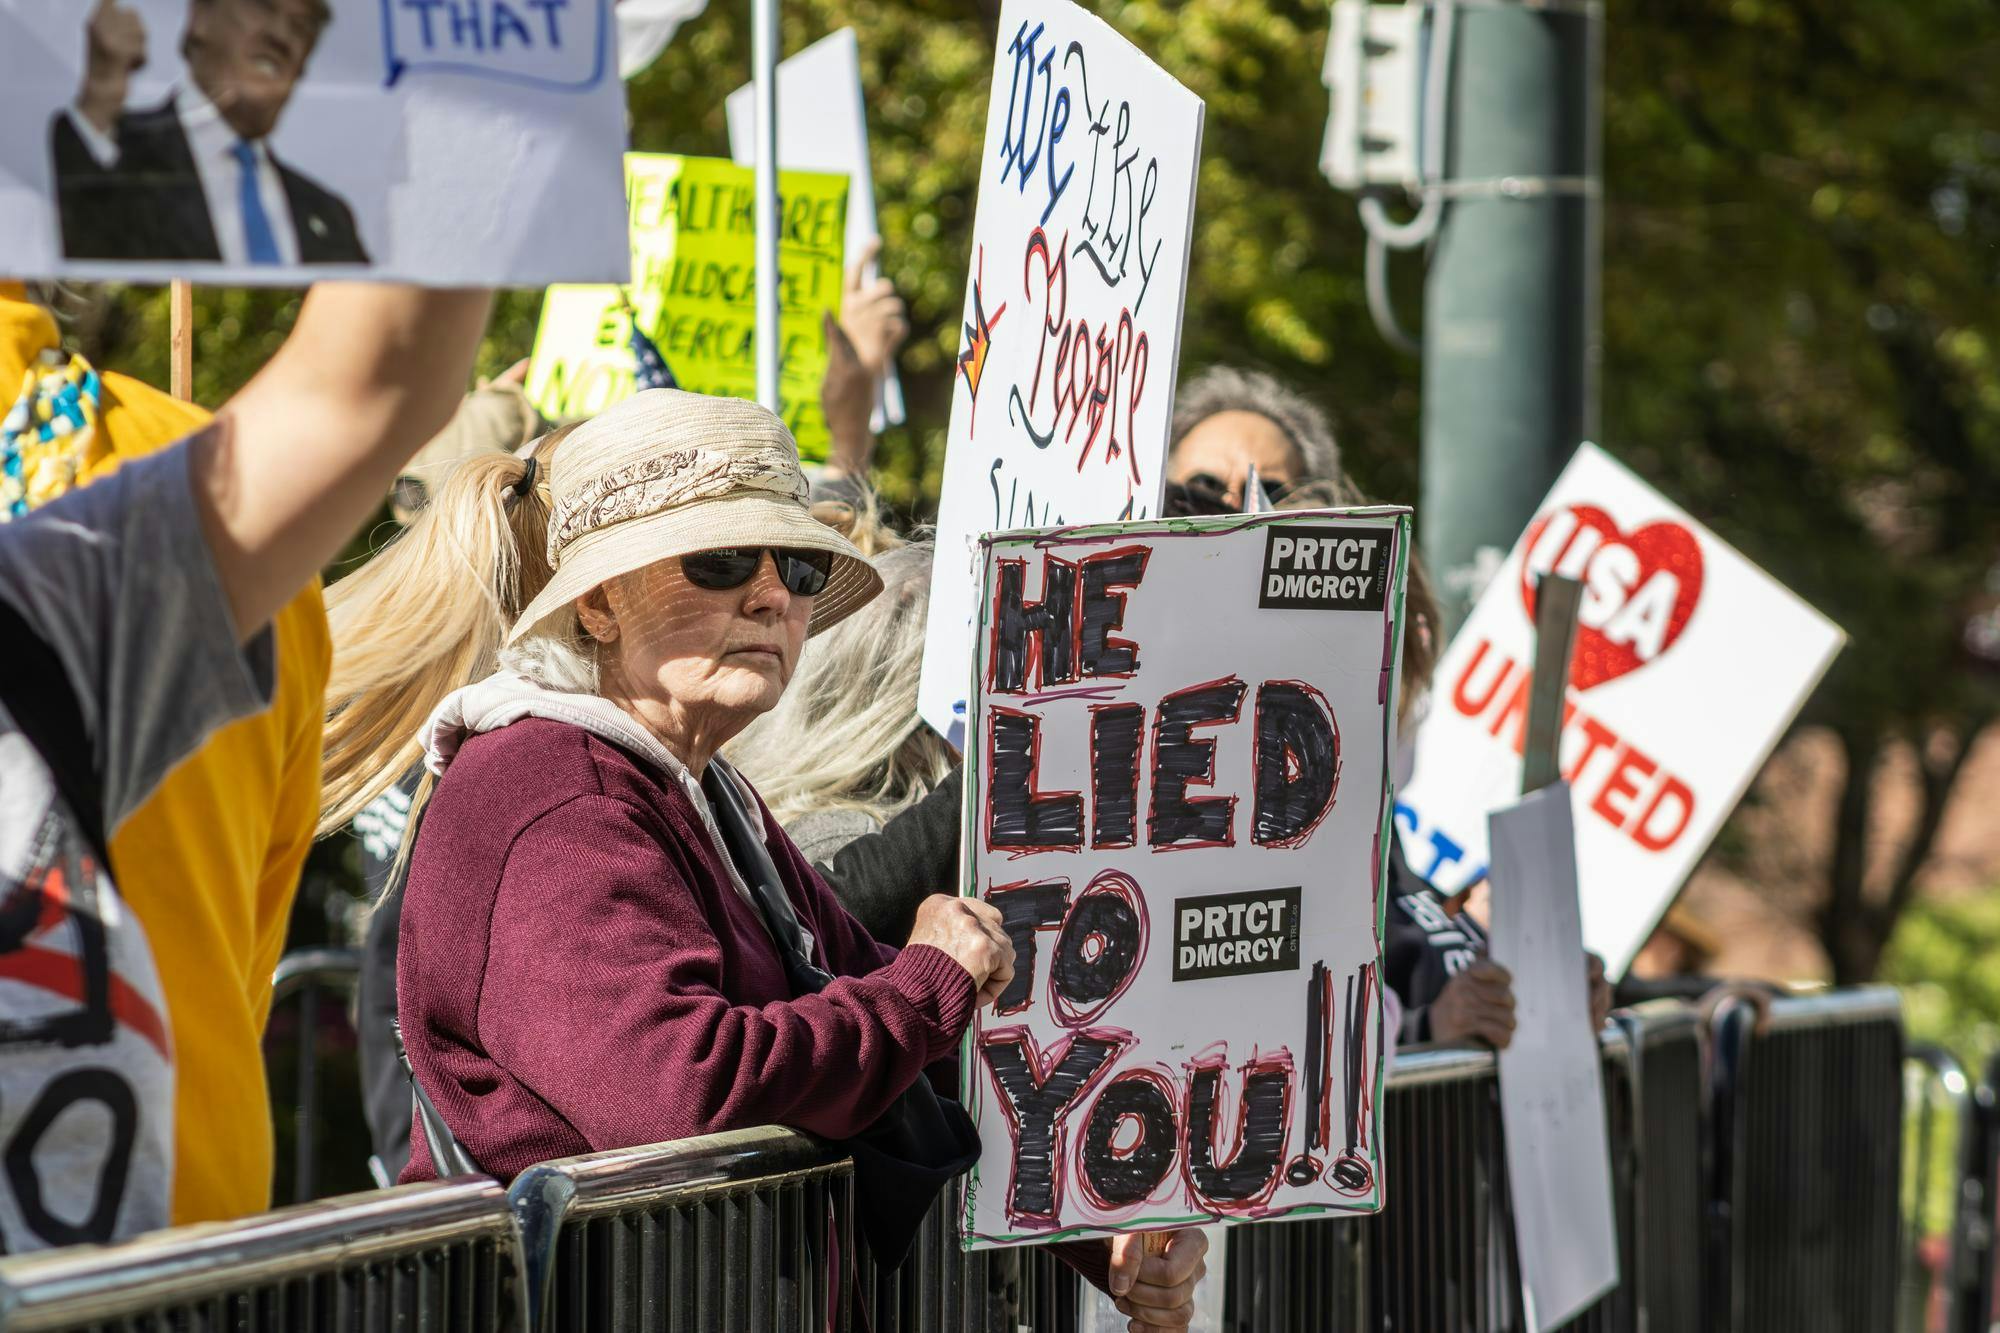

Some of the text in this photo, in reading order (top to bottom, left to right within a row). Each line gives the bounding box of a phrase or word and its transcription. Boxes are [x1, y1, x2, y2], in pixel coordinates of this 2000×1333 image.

[402, 0, 568, 51] THAT
[1000, 19, 1075, 228] We
[1010, 226, 1150, 486] People
[1267, 574, 1372, 599] DMCRCY
[1270, 537, 1377, 571] PRTCT
[988, 545, 1152, 694] HE
[986, 674, 1342, 856] LIED
[985, 868, 1151, 1028] TO
[1179, 936, 1284, 970] DMCRCY
[1180, 899, 1286, 941] PRTCT
